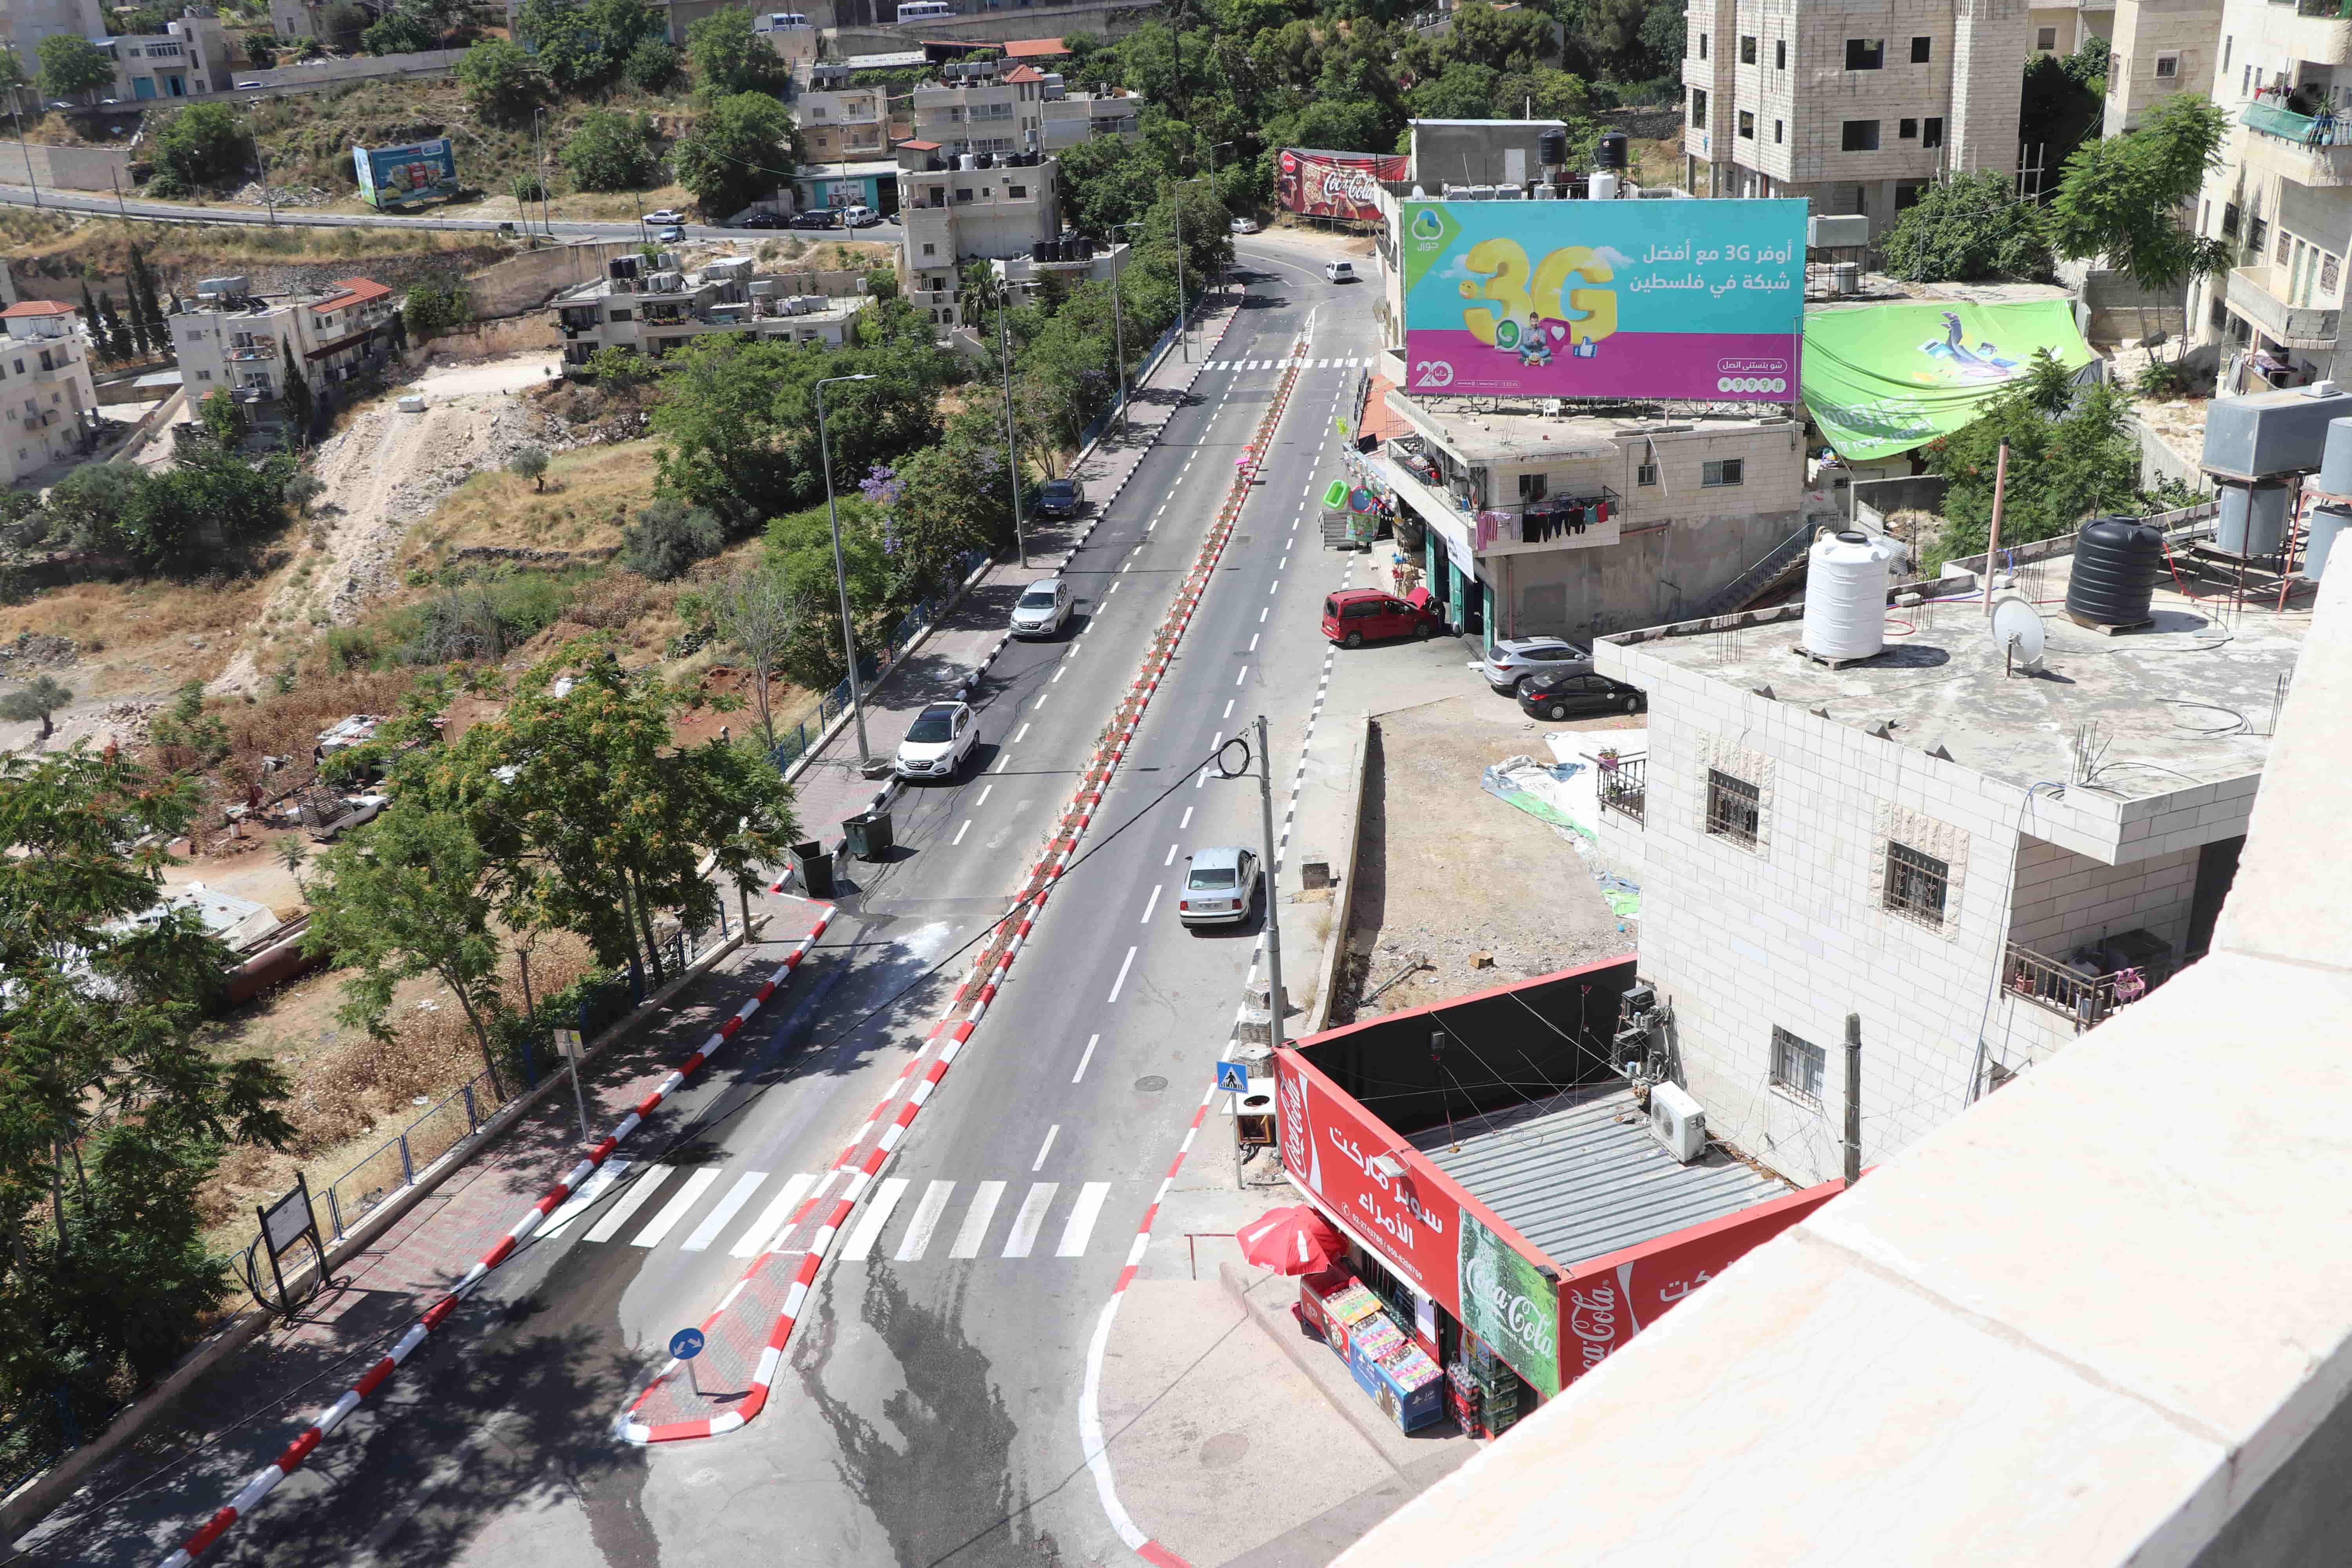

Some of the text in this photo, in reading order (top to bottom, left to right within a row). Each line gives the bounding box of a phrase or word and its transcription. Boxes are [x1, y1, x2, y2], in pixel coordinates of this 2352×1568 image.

[1643, 238, 1793, 265] أوفر 3G مع أفضل
[1463, 238, 1617, 350] 3G
[1630, 271, 1791, 298] شبكة في فلسطين
[1414, 361, 1454, 387] 20
[1722, 361, 1782, 370] شو بتستنى اتصل
[1329, 1126, 1443, 1234] سوبر ماركت
[1358, 1192, 1414, 1250] الأمراء
